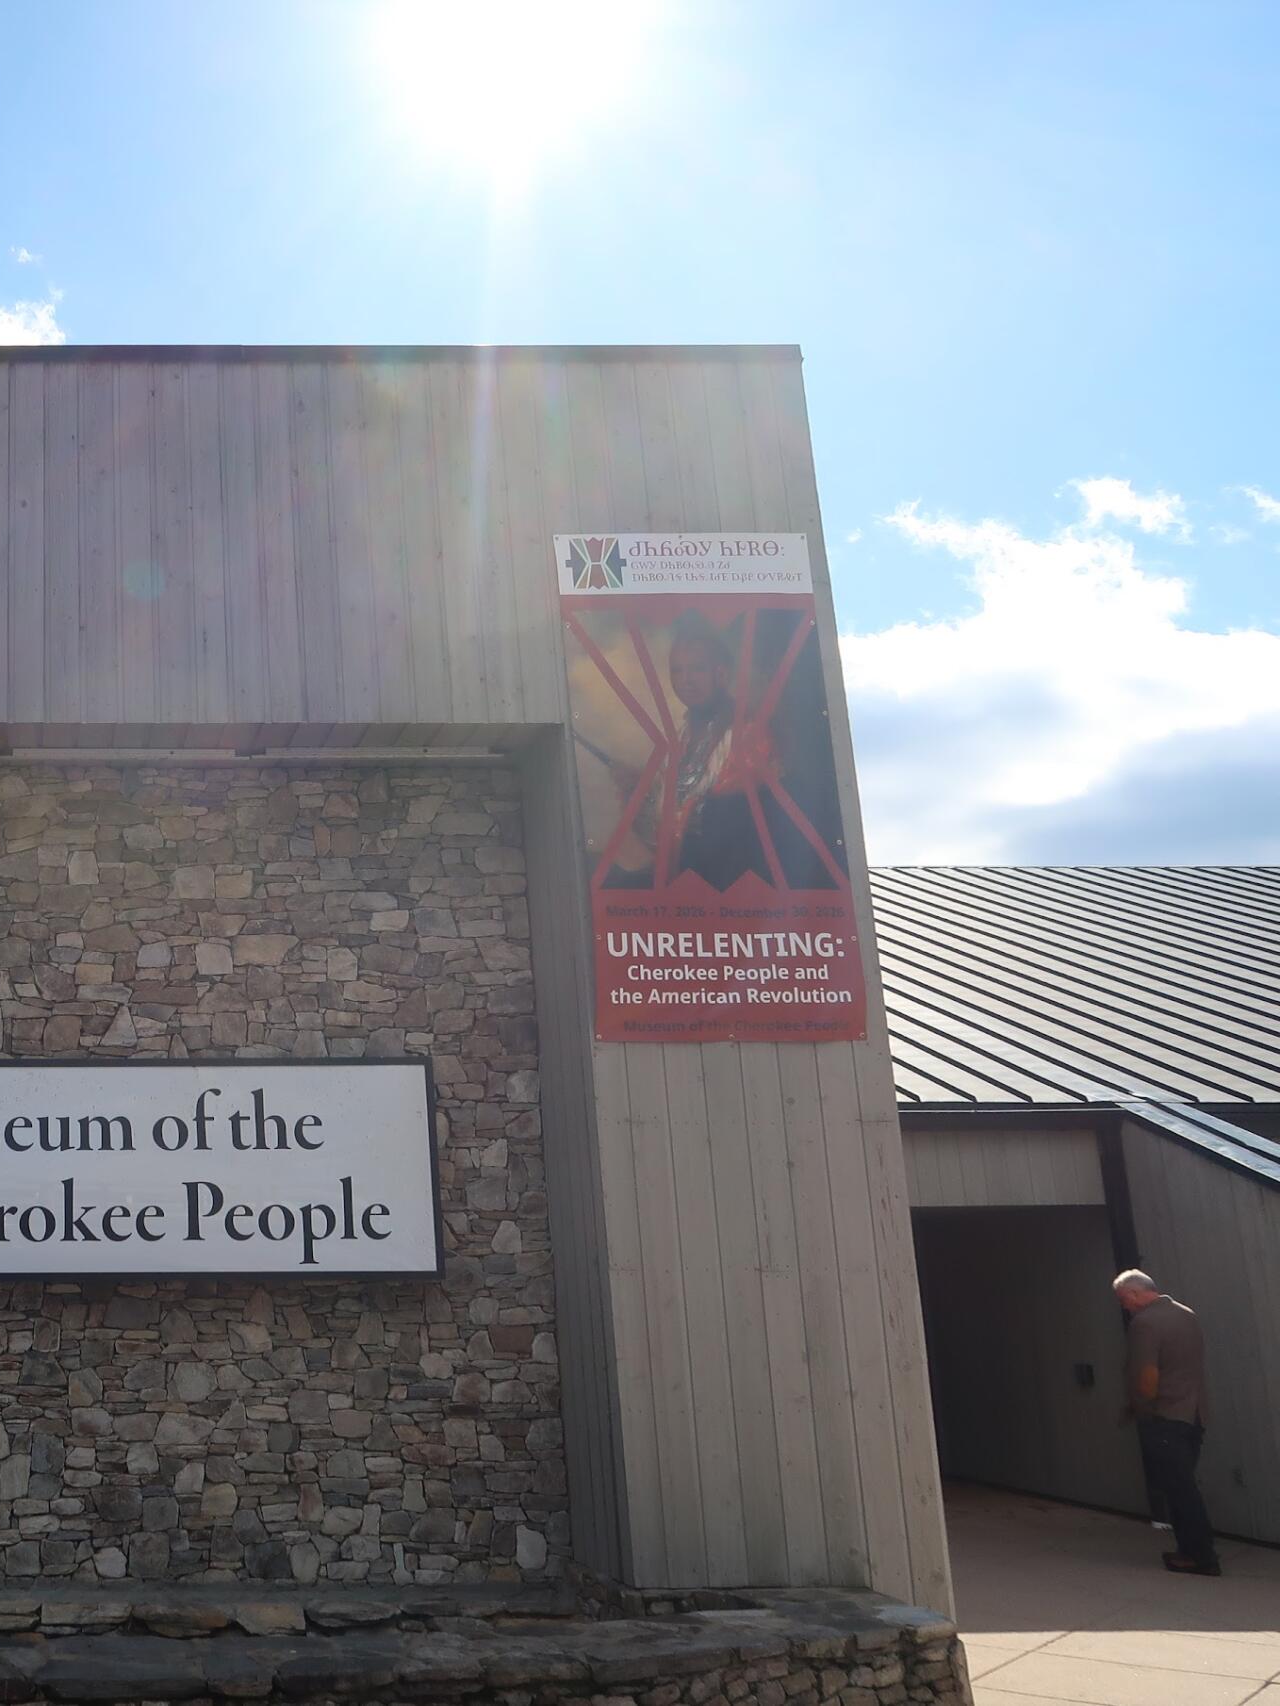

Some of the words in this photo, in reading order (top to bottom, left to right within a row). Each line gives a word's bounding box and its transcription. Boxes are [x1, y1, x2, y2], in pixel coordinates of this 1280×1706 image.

[606, 906, 648, 918] March
[674, 906, 706, 918] 2026
[720, 907, 785, 919] December
[607, 932, 846, 958] UNRELENTING:
[627, 964, 719, 981] Cherokee
[723, 965, 790, 985] People
[794, 965, 830, 980] and
[610, 988, 643, 1004] the
[647, 988, 741, 1004] American
[747, 988, 853, 1004] Revolution
[624, 1020, 685, 1032] Museum
[689, 1019, 704, 1032] of
[735, 1020, 801, 1032] Cherokee
[152, 1088, 222, 1152] of
[229, 1089, 324, 1151] the
[181, 1175, 392, 1265] People
